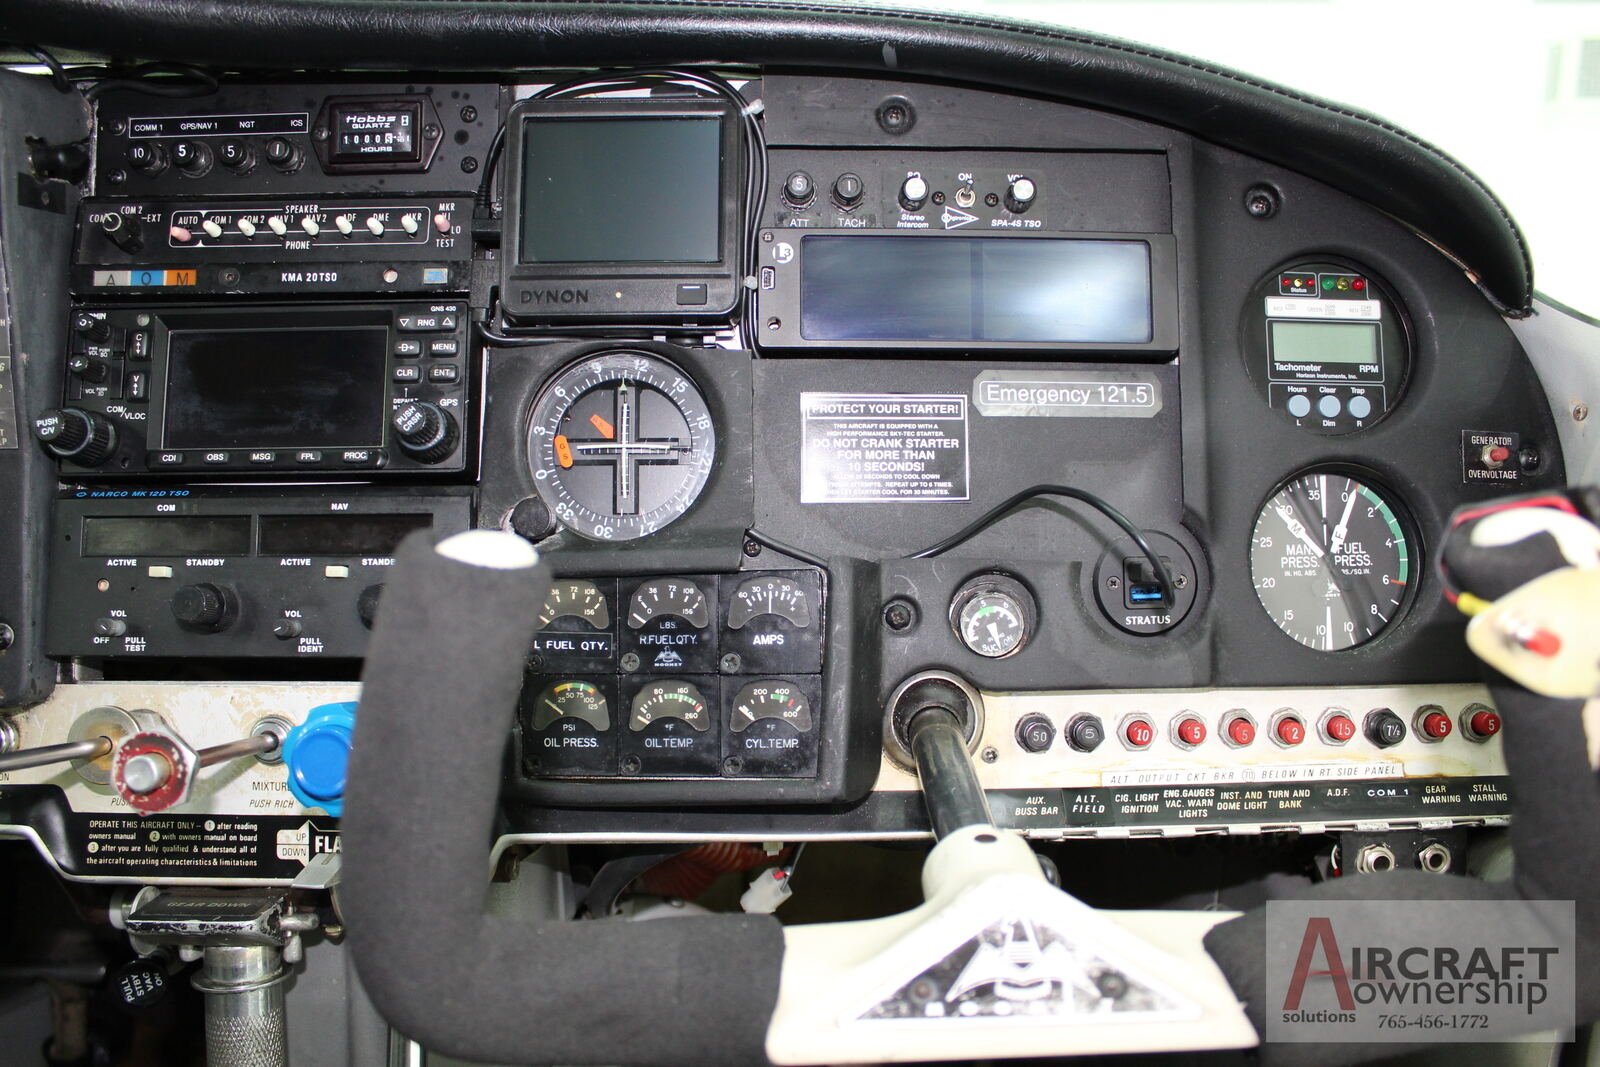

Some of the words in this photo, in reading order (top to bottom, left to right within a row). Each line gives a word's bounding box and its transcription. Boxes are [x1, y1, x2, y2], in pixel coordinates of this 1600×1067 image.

[239, 120, 255, 128] NGT
[290, 119, 304, 127] ICS
[346, 115, 396, 123] Hobbs
[134, 124, 158, 132] COMM
[180, 122, 212, 130] GPS/NAV
[134, 147, 144, 158] 10
[178, 145, 186, 157] 5
[227, 146, 235, 158] 5
[120, 206, 137, 214] COM
[286, 205, 318, 214] SPEAKER
[439, 203, 455, 212] MKR
[178, 216, 198, 224] AUTO
[790, 218, 810, 227] ATT
[838, 218, 866, 228] TACH
[901, 214, 925, 222] Stereo
[896, 220, 929, 228] Intercom
[991, 219, 1022, 228] SPA-4S
[1024, 220, 1042, 228] TSO
[286, 241, 310, 250] PHONE
[436, 239, 454, 248] TEST
[282, 272, 303, 282] KMA
[306, 272, 318, 282] 20
[320, 272, 337, 282] TSO
[520, 290, 588, 304] DYNON
[634, 360, 649, 372] 12
[1274, 363, 1322, 372] Tachometer
[1359, 365, 1379, 373] RPM
[987, 384, 1090, 405] Emergency
[1098, 386, 1148, 404] 121.5
[1350, 387, 1366, 395] Trap
[440, 398, 458, 407] GPS
[812, 404, 866, 414] PROTECT
[868, 404, 901, 414] YOUR
[904, 404, 959, 414] STARTER!
[36, 417, 58, 428] PUSH
[812, 438, 831, 449] DO
[833, 438, 858, 448] NOT
[861, 438, 903, 448] CRANK
[905, 438, 960, 448] STARTER
[1471, 435, 1512, 446] GENERATOR
[838, 450, 862, 460] FOR
[865, 450, 900, 460] MORE
[902, 450, 936, 460] THAN
[864, 462, 925, 472] SECONDS!
[1468, 469, 1518, 480] OVERVOLTAGE
[1260, 538, 1272, 548] 25
[1286, 544, 1314, 556] MAN.
[1337, 543, 1366, 554] FUEL
[1280, 557, 1320, 568] PRESS.
[1334, 555, 1373, 566] PRESS.
[1126, 615, 1171, 626] STRATUS
[752, 634, 784, 645] AMPS
[546, 640, 576, 650] FUEL
[580, 641, 608, 651] QTY.
[1440, 721, 1447, 734] 5
[1488, 719, 1495, 731] 5
[1032, 731, 1047, 742] 50
[1193, 726, 1201, 738] 5
[1291, 727, 1299, 740] 2
[544, 738, 560, 748] OIL
[562, 738, 599, 748] PRESS.
[644, 738, 662, 748] OIL
[662, 738, 694, 748] TEMP.
[1138, 774, 1180, 783] OUTPUT
[1186, 772, 1206, 781] CKT
[1214, 771, 1235, 781] BKR
[1261, 770, 1298, 779] BELOW
[1337, 767, 1359, 776] SIDE
[1364, 766, 1396, 776] PANEL
[1268, 790, 1291, 798] TURN
[1292, 789, 1310, 798] AND
[1326, 788, 1350, 798] A.D.F.
[1426, 785, 1447, 794] GEAR
[1472, 784, 1497, 793] STALL
[1026, 796, 1046, 805] AUX.
[1076, 794, 1100, 804] ALT.
[1114, 794, 1132, 802] CIG.
[1135, 792, 1160, 802] LIGHT
[1220, 792, 1242, 800] INST.
[1245, 791, 1263, 800] AND
[1422, 794, 1462, 804] WARNING
[1468, 793, 1508, 803] WARNING
[250, 799, 272, 808] PUSH
[274, 800, 294, 808] RICH
[1165, 799, 1184, 808] VAC.
[1188, 798, 1214, 808] WARN
[1217, 802, 1241, 811] DOME
[1244, 800, 1268, 810] LIGHT
[1279, 800, 1302, 810] BANK
[1015, 807, 1038, 816] BUSS
[1040, 806, 1058, 816] BAR
[1072, 804, 1105, 814] FIELD
[1121, 804, 1159, 814] IGNITION
[1178, 809, 1208, 818] LIGHTS
[90, 820, 120, 828] OPERATE
[122, 820, 138, 829] THIS
[140, 820, 174, 829] AIRCRAFT
[234, 823, 258, 832] reading
[162, 833, 177, 841] with
[204, 834, 226, 842] manual
[240, 834, 258, 842] board
[162, 844, 189, 854] qualified
[202, 845, 236, 854] understand
[314, 835, 341, 853] FLA
[282, 848, 306, 857] DOWN
[98, 857, 125, 865] aircraft
[126, 858, 159, 867] operating
[160, 858, 212, 866] characteristics
[219, 858, 258, 866] limitations
